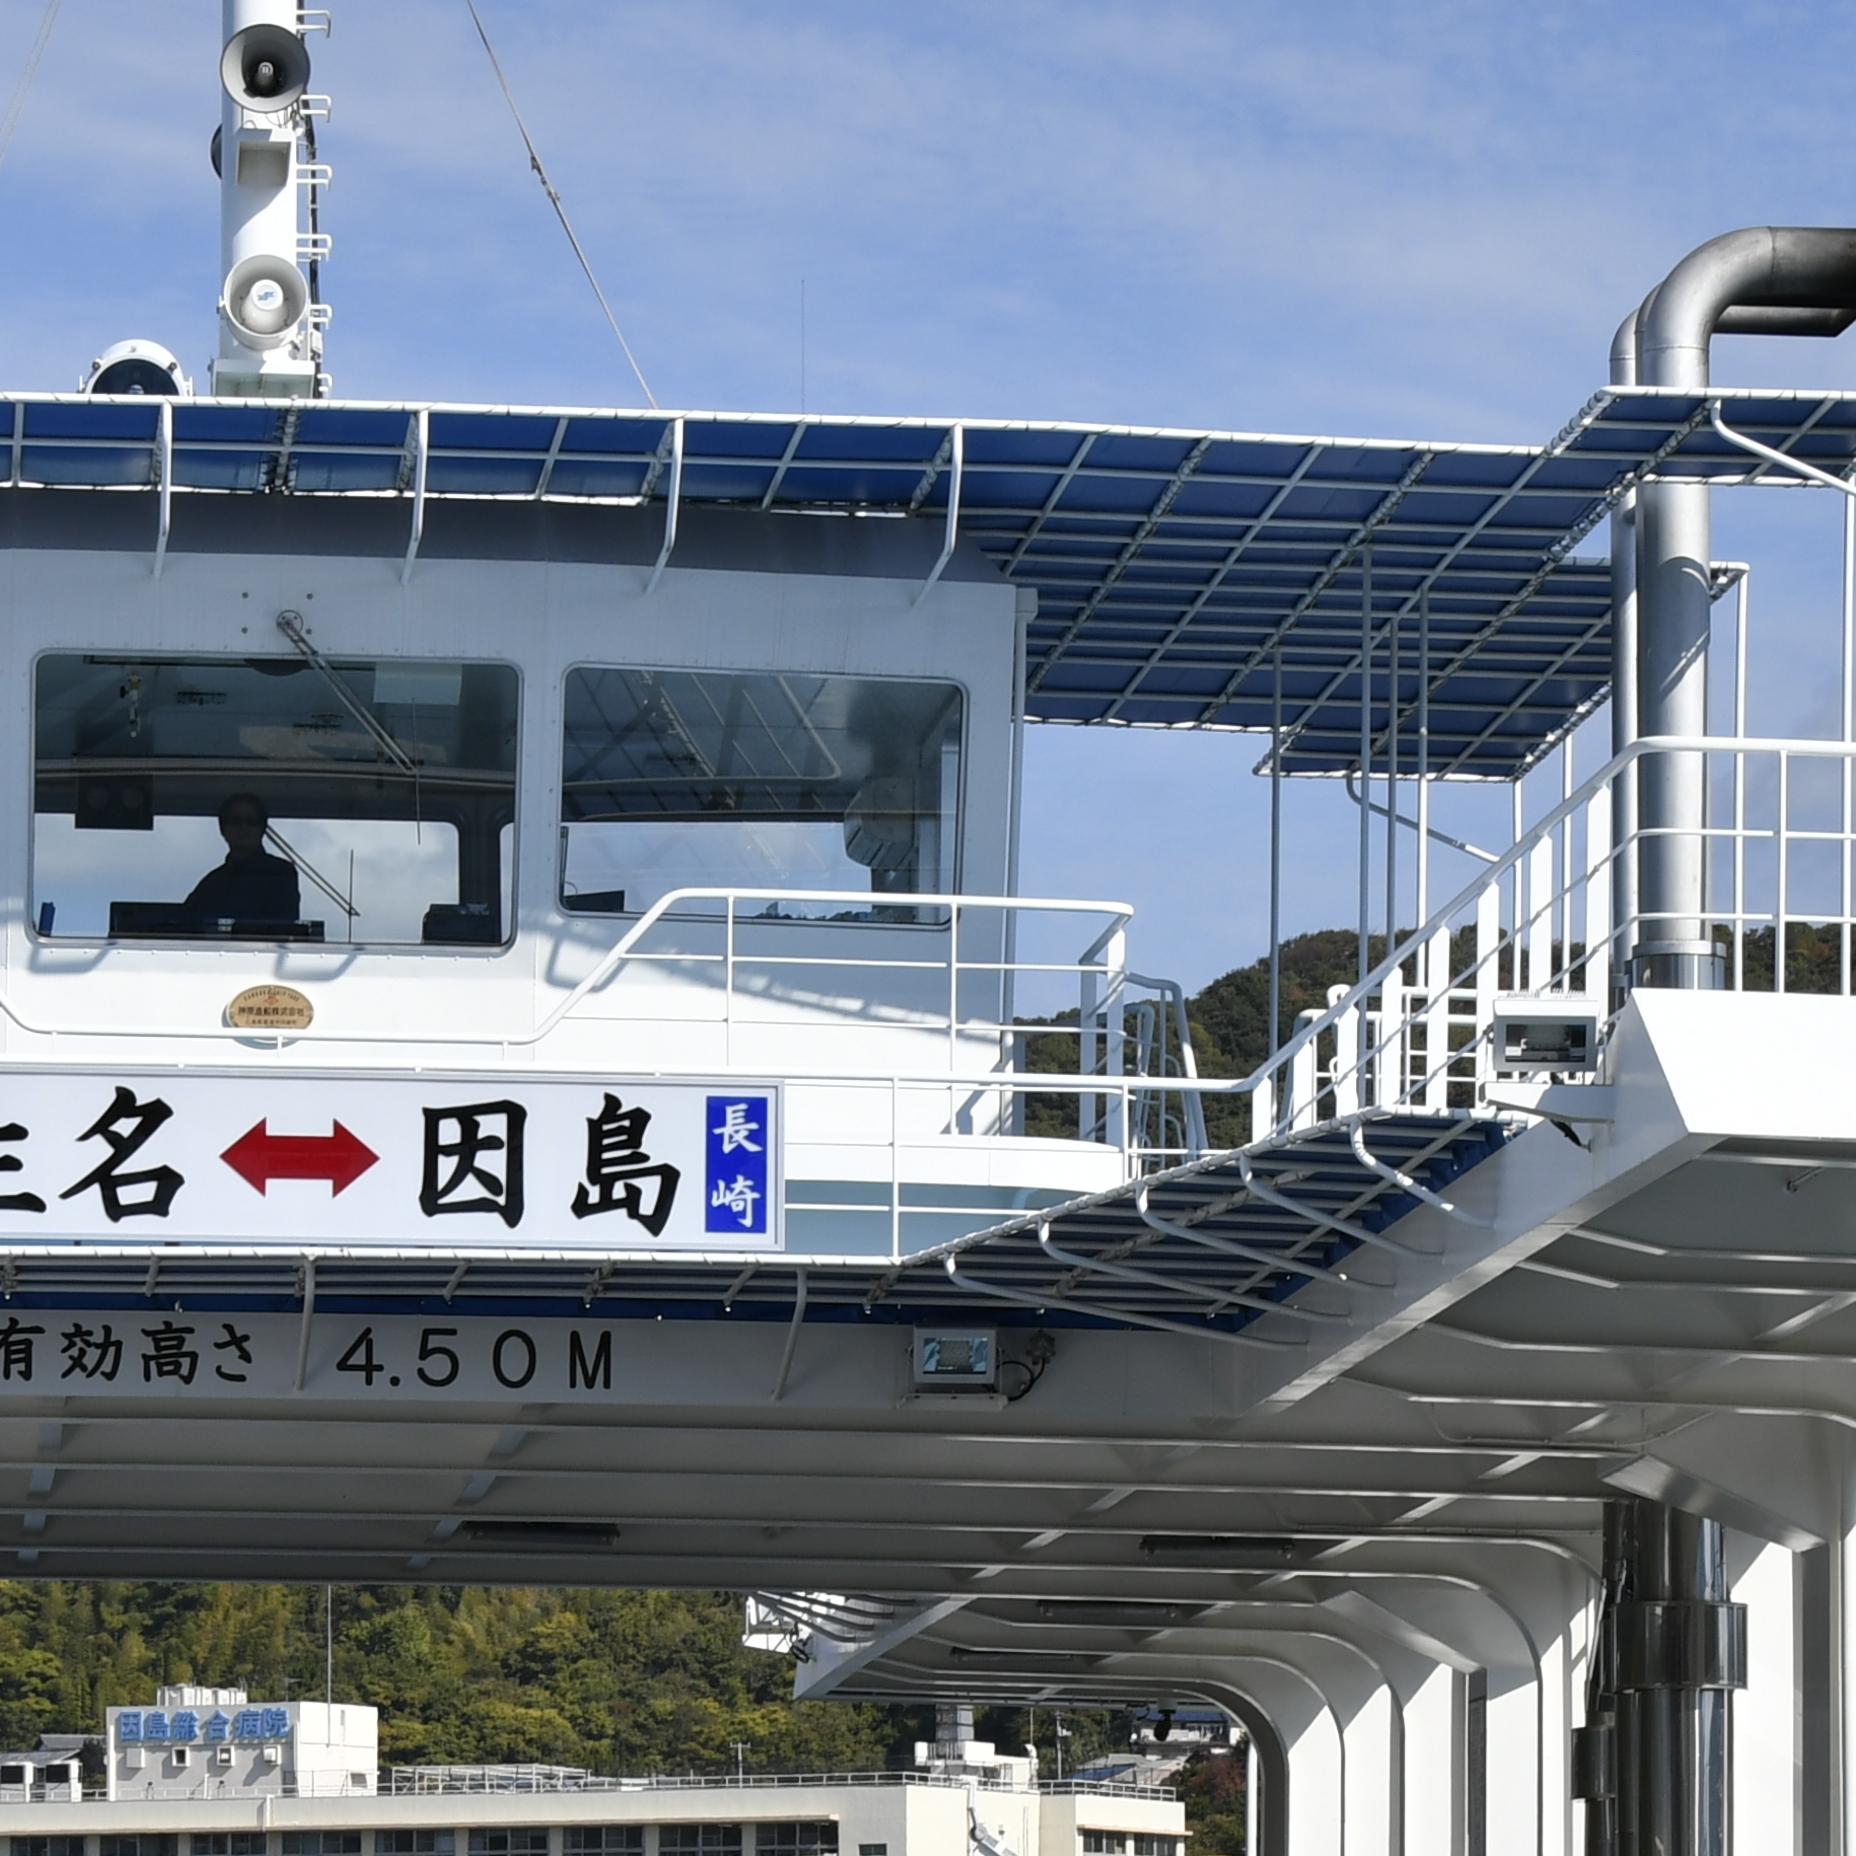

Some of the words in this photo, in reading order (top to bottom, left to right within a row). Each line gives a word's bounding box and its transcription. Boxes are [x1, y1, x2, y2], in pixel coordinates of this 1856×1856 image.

[416, 1092, 681, 1239] 因島
[710, 1103, 764, 1229] 長崎
[119, 1707, 291, 1742] 因島総合病院
